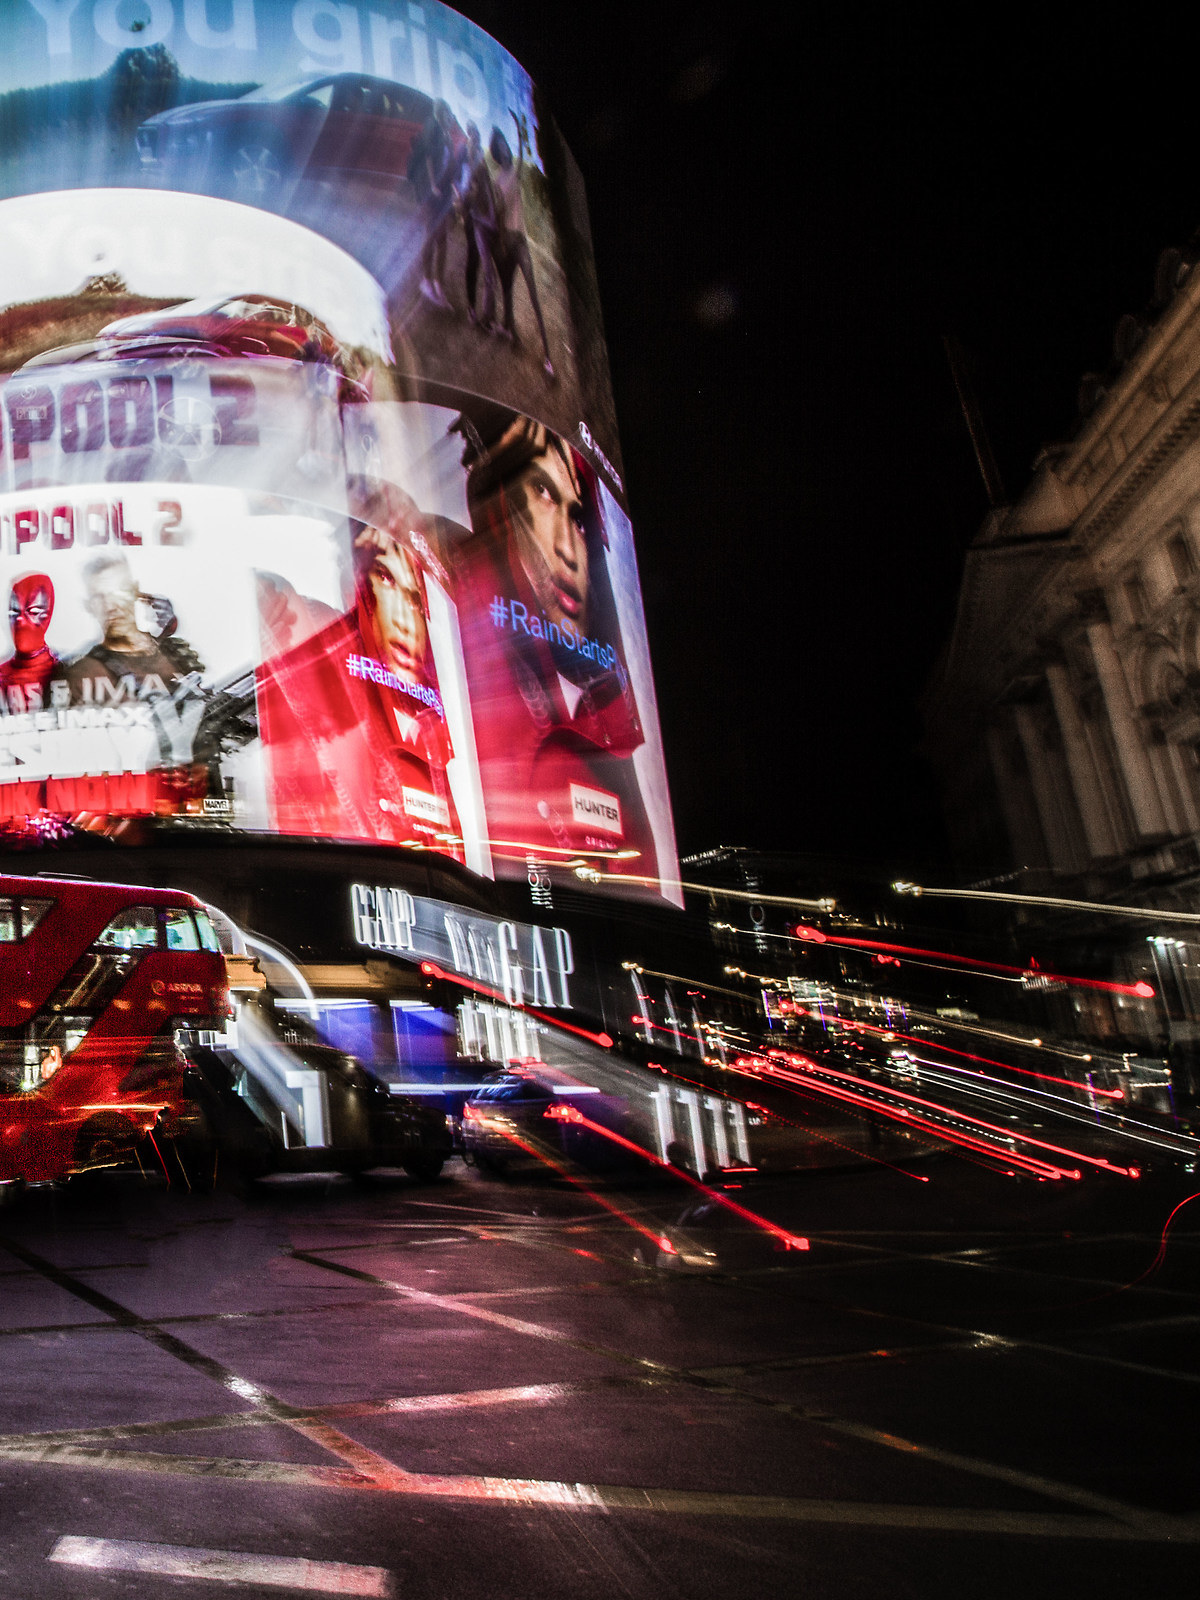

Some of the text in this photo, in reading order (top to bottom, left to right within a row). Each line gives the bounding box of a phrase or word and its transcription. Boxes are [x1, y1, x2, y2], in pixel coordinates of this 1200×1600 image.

[23, 0, 490, 122] You grip
[209, 374, 260, 446] 2
[157, 500, 185, 546] 2
[81, 671, 208, 702] IMAX
[405, 797, 437, 812] HUNTER
[574, 798, 619, 821] HUNTER
[497, 921, 574, 1009] GAP
